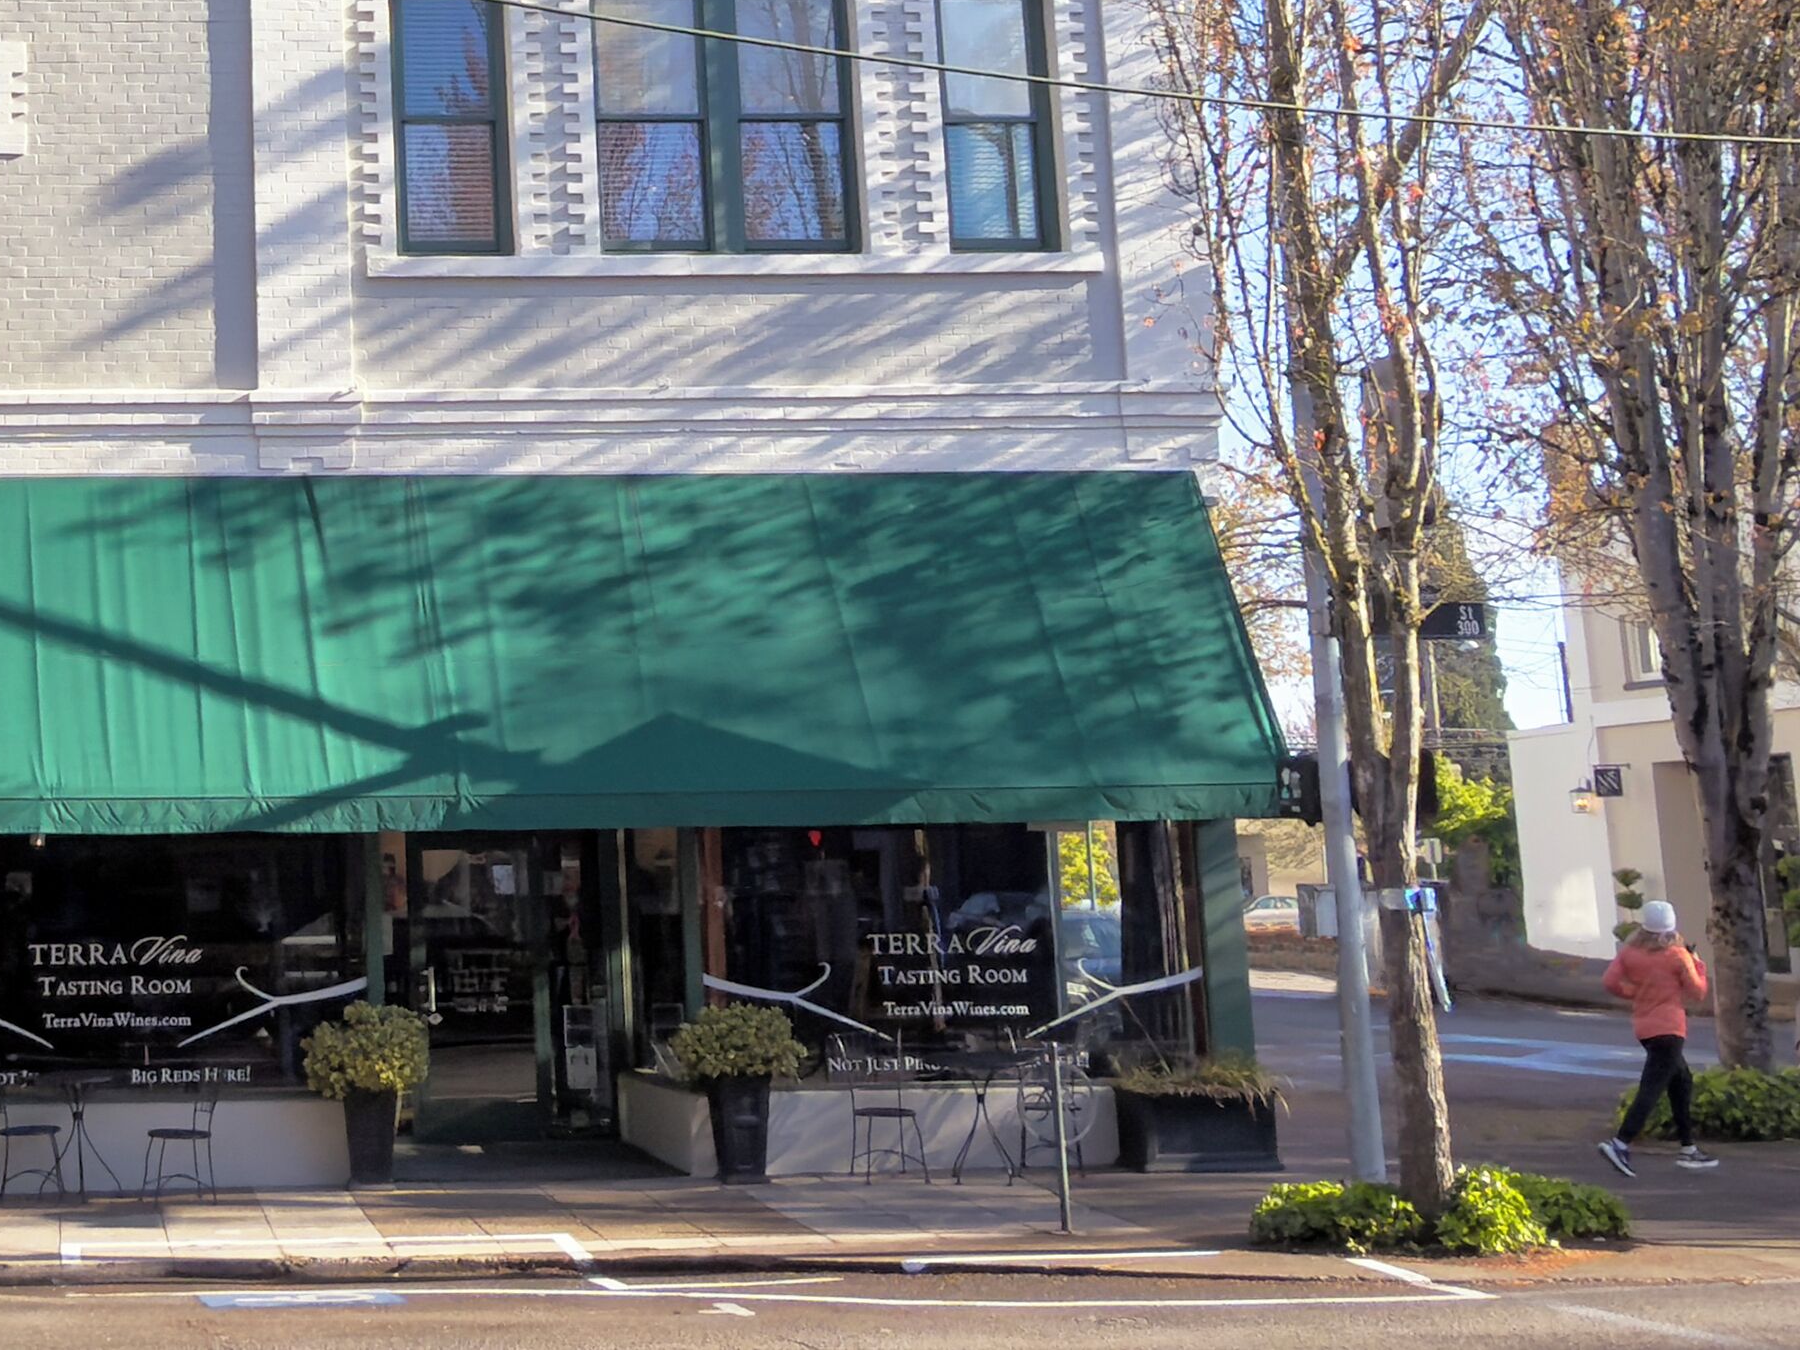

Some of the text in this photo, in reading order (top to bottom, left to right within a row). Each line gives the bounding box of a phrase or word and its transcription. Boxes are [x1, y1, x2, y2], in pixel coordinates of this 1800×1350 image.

[1459, 605, 1474, 620] St
[1457, 620, 1480, 635] 300
[866, 924, 1038, 956] TERRA Vina
[28, 934, 205, 966] TERRA Vina
[882, 1000, 1031, 1017] TerraVinaWines.com
[42, 1011, 193, 1029] TerraVinaWines.com
[204, 1065, 251, 1083] HRE!
